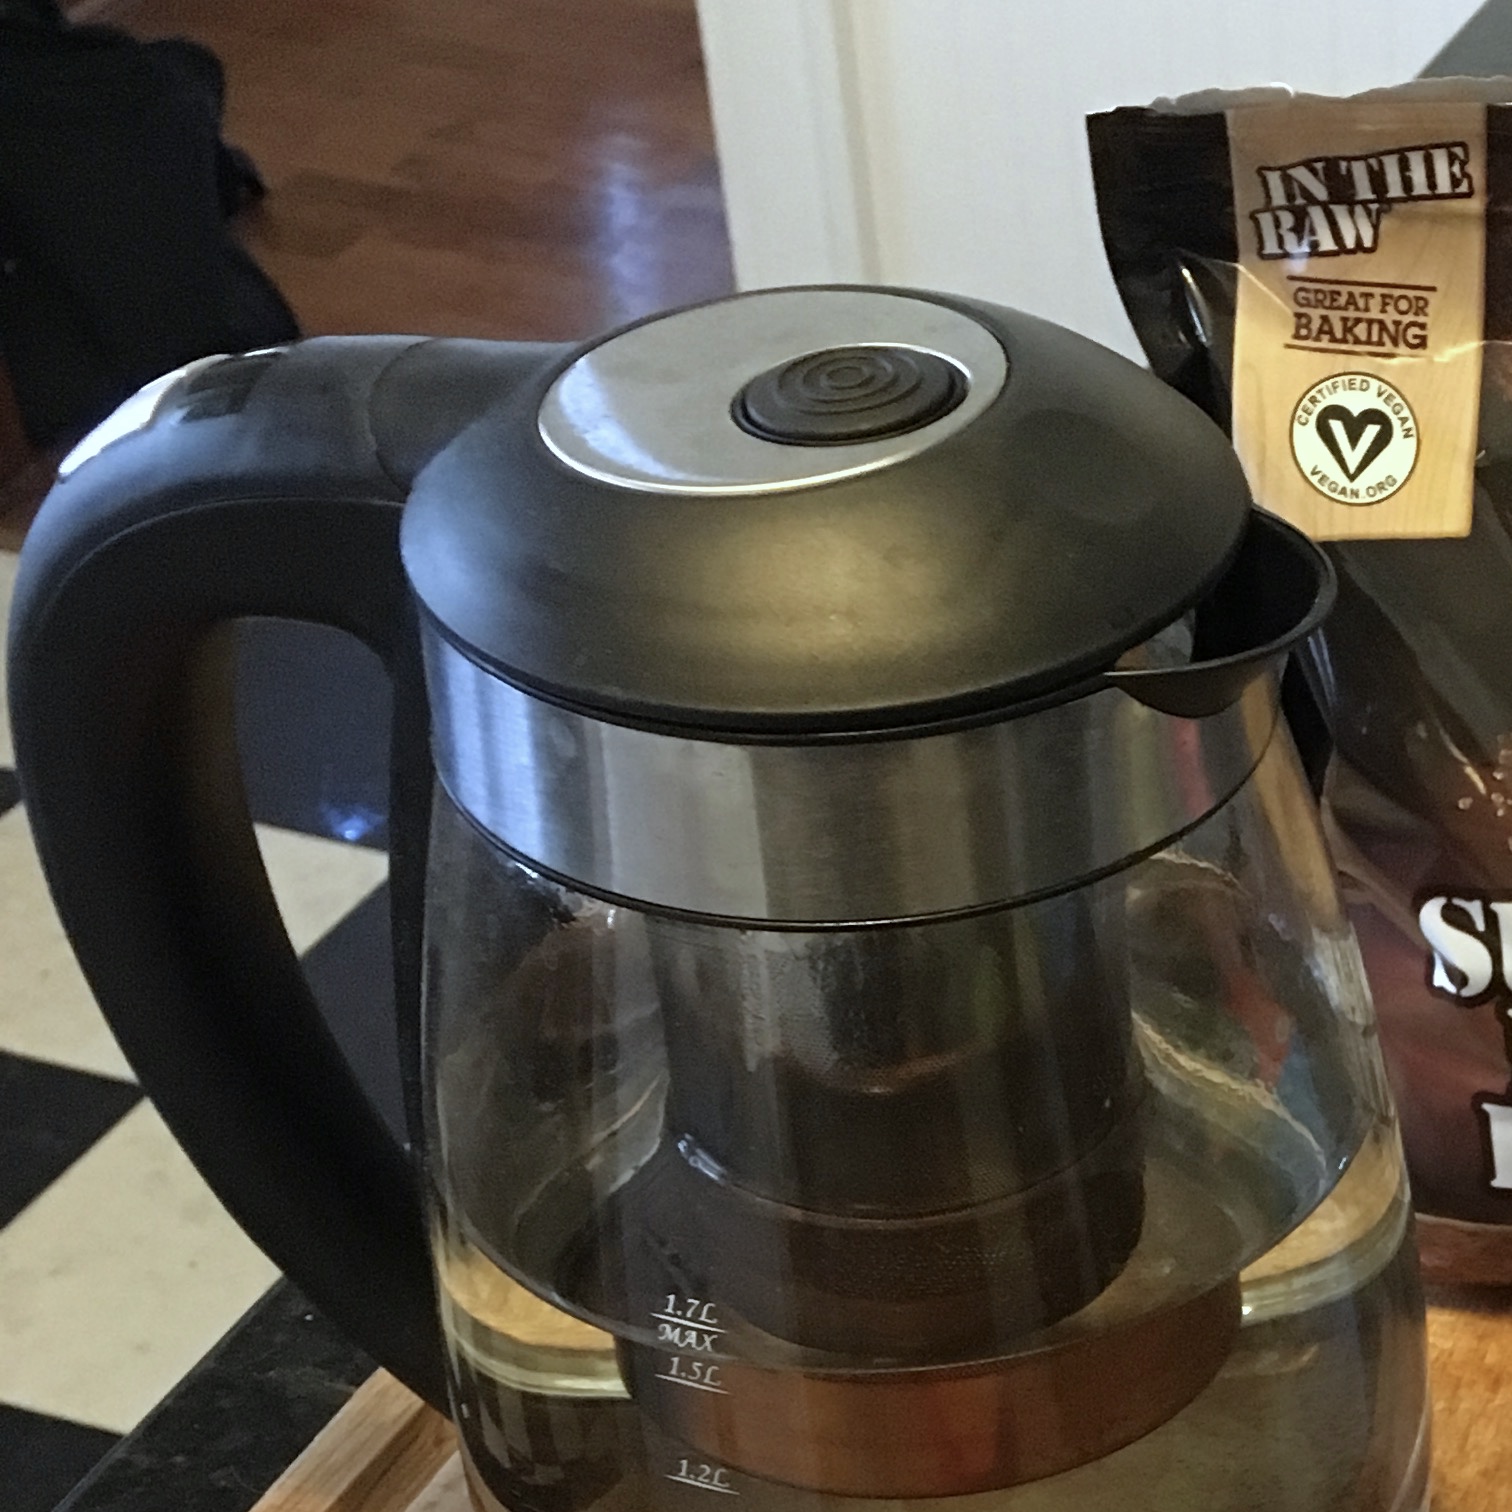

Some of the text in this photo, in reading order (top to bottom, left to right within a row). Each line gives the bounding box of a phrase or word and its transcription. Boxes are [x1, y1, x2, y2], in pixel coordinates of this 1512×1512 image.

[1258, 145, 1472, 206] IN THE
[1254, 203, 1381, 256] RAW
[1294, 286, 1430, 317] GREAT FOR
[1292, 312, 1429, 351] BAKING
[1296, 377, 1415, 440] CERTIFIED VEGAN
[658, 1323, 718, 1353] MAX
